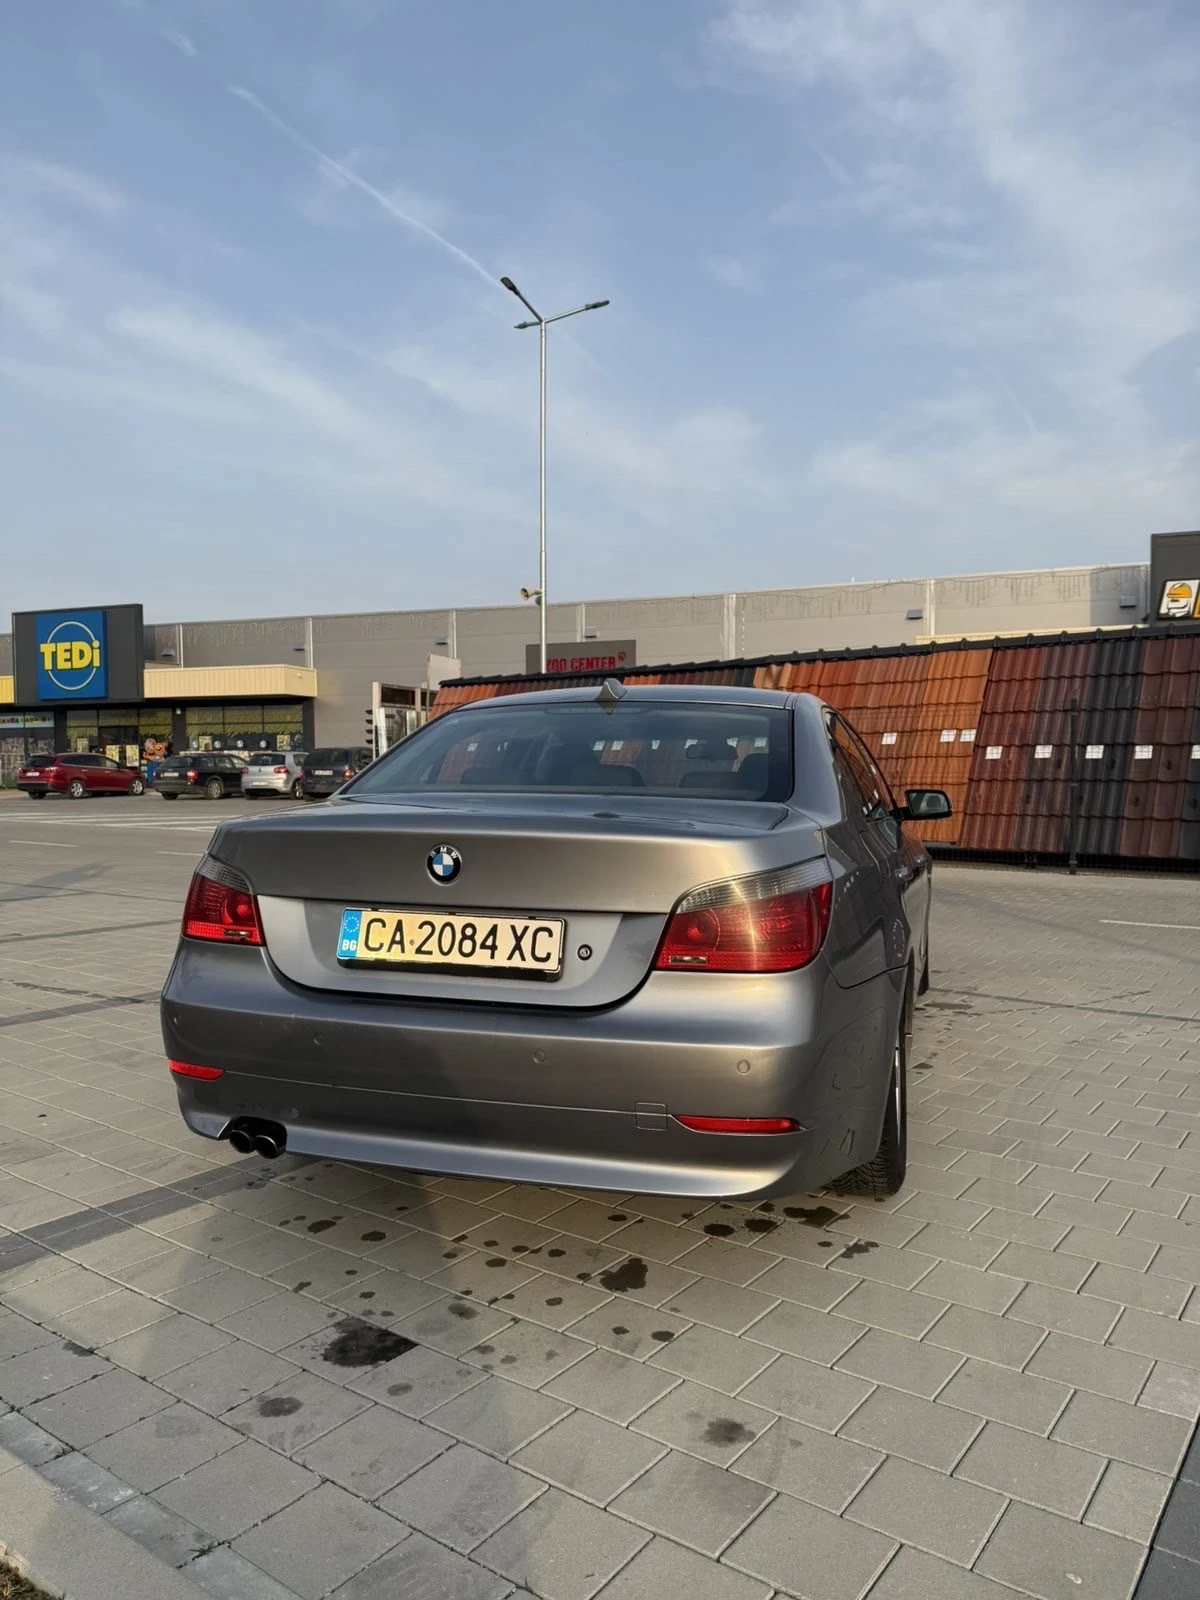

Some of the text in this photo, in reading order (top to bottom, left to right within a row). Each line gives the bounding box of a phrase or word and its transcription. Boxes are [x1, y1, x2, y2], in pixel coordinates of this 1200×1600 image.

[39, 639, 101, 671] TEDi
[570, 656, 616, 671] CENTER
[430, 846, 459, 859] BMW
[342, 939, 357, 952] BG
[364, 917, 554, 963] CA 2084 XC
